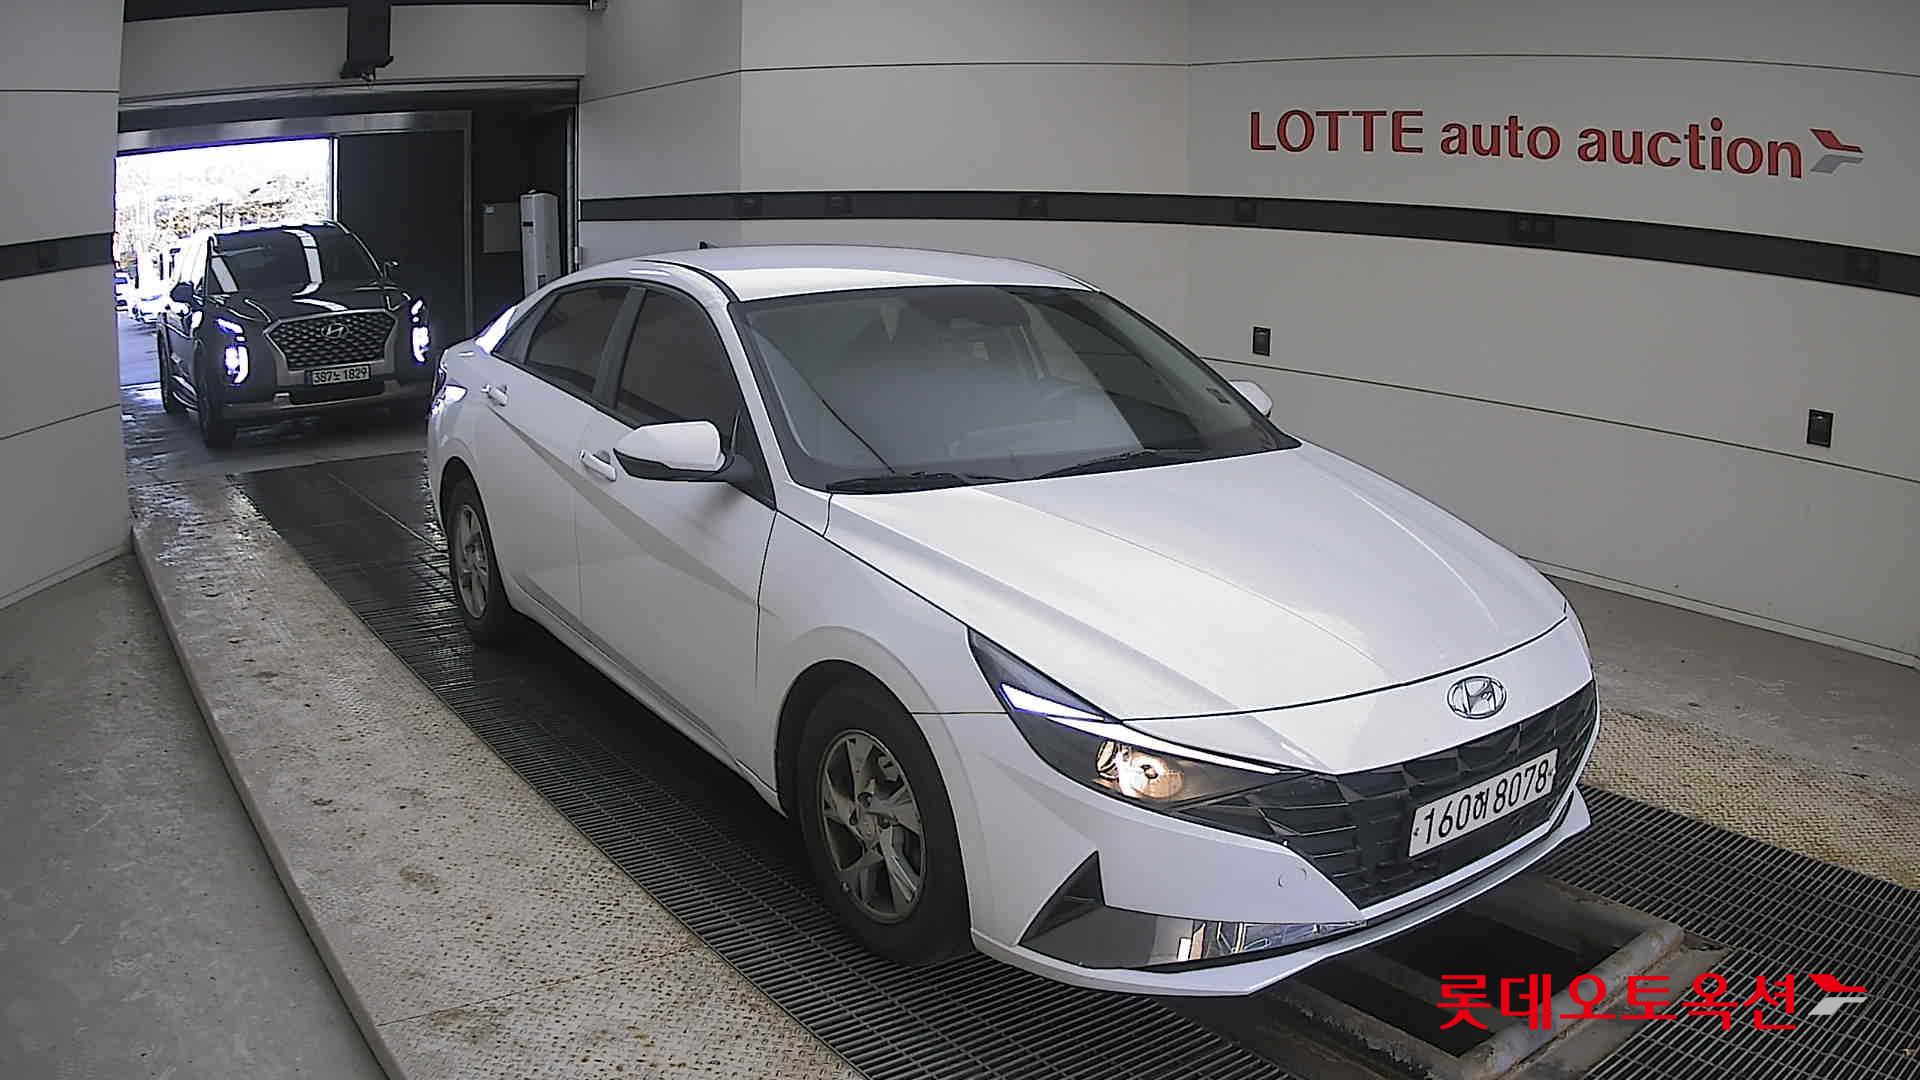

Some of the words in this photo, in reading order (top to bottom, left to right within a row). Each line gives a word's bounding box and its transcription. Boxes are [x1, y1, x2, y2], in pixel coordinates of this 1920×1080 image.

[1250, 109, 1424, 154] LOTTE
[1440, 115, 1561, 161] auto
[1578, 117, 1803, 179] auction
[1423, 787, 1490, 845] 160허
[1493, 759, 1549, 814] 8078
